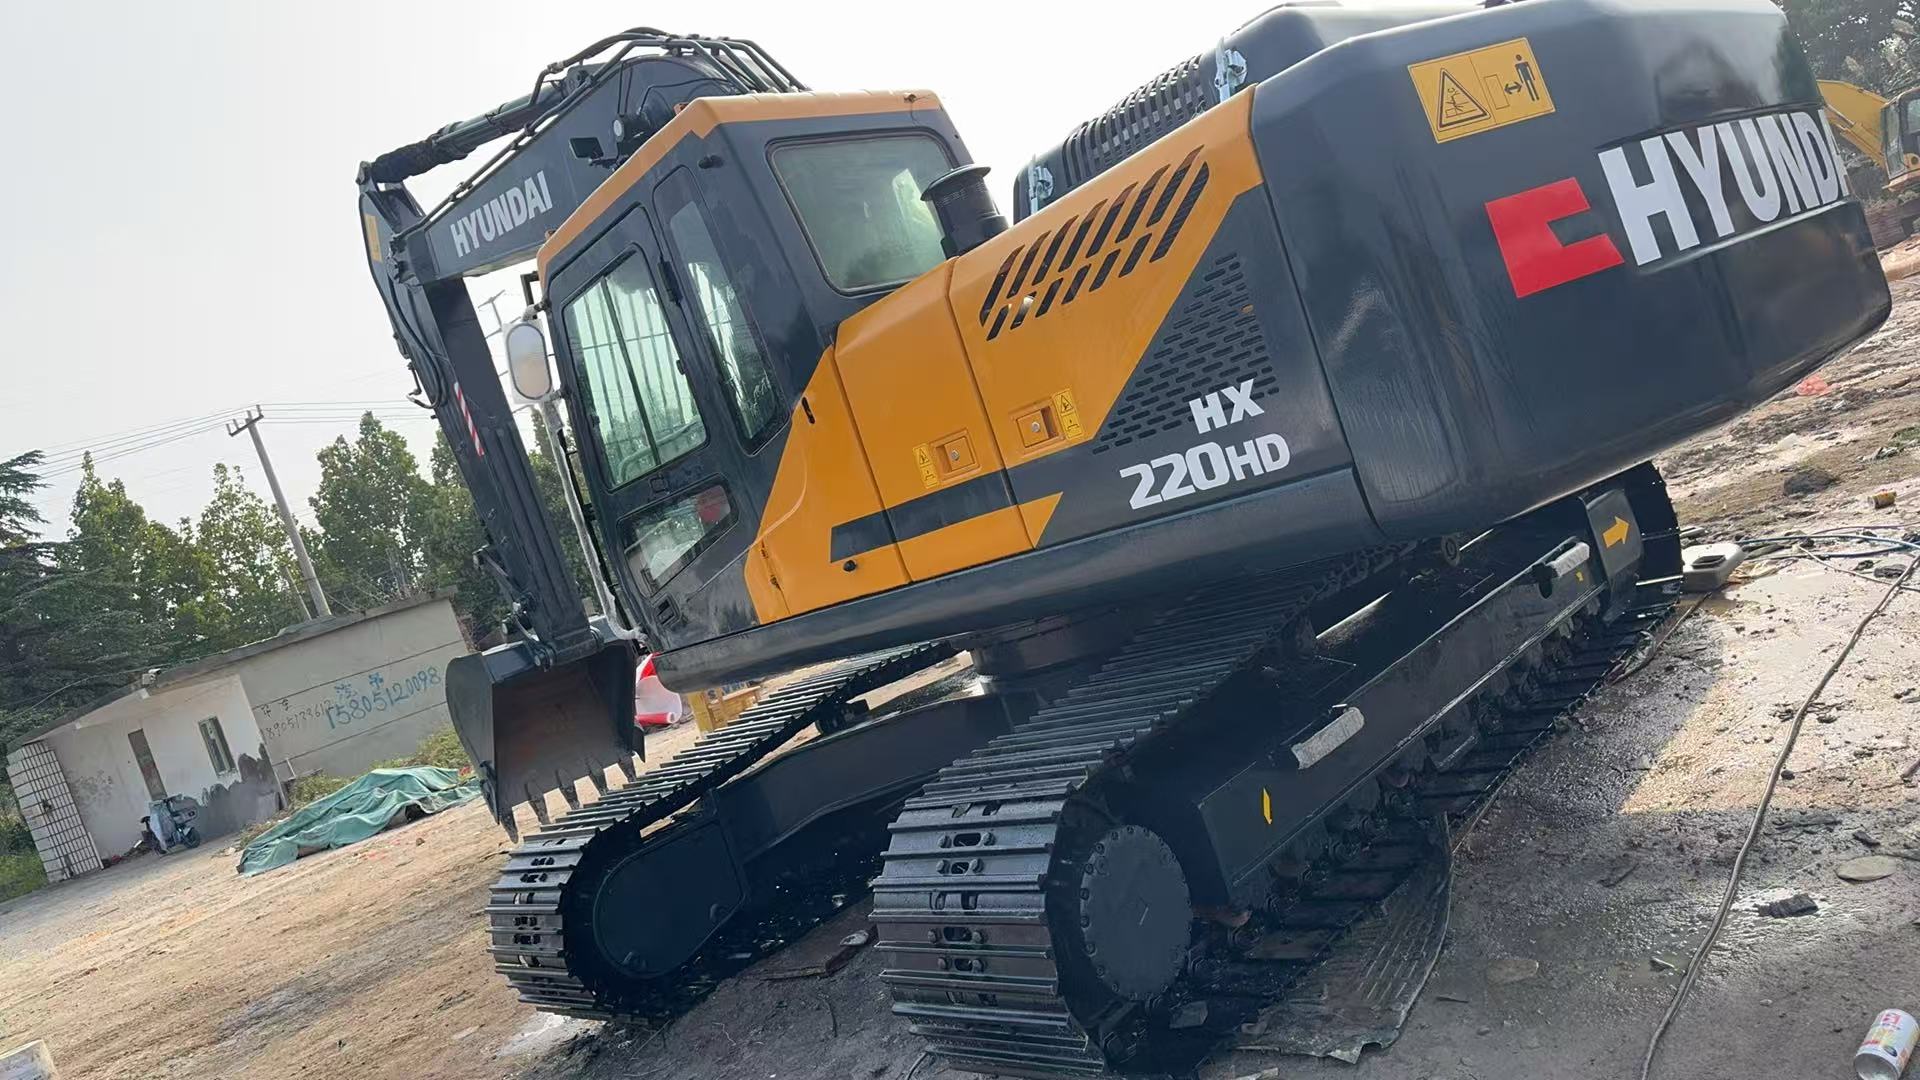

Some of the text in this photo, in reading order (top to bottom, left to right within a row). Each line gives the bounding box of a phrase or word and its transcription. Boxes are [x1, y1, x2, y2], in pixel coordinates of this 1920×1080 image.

[450, 170, 553, 258] HYUNDAI
[1189, 379, 1264, 434] HX
[1119, 433, 1290, 510] 220HD
[325, 667, 442, 729] 15805120098
